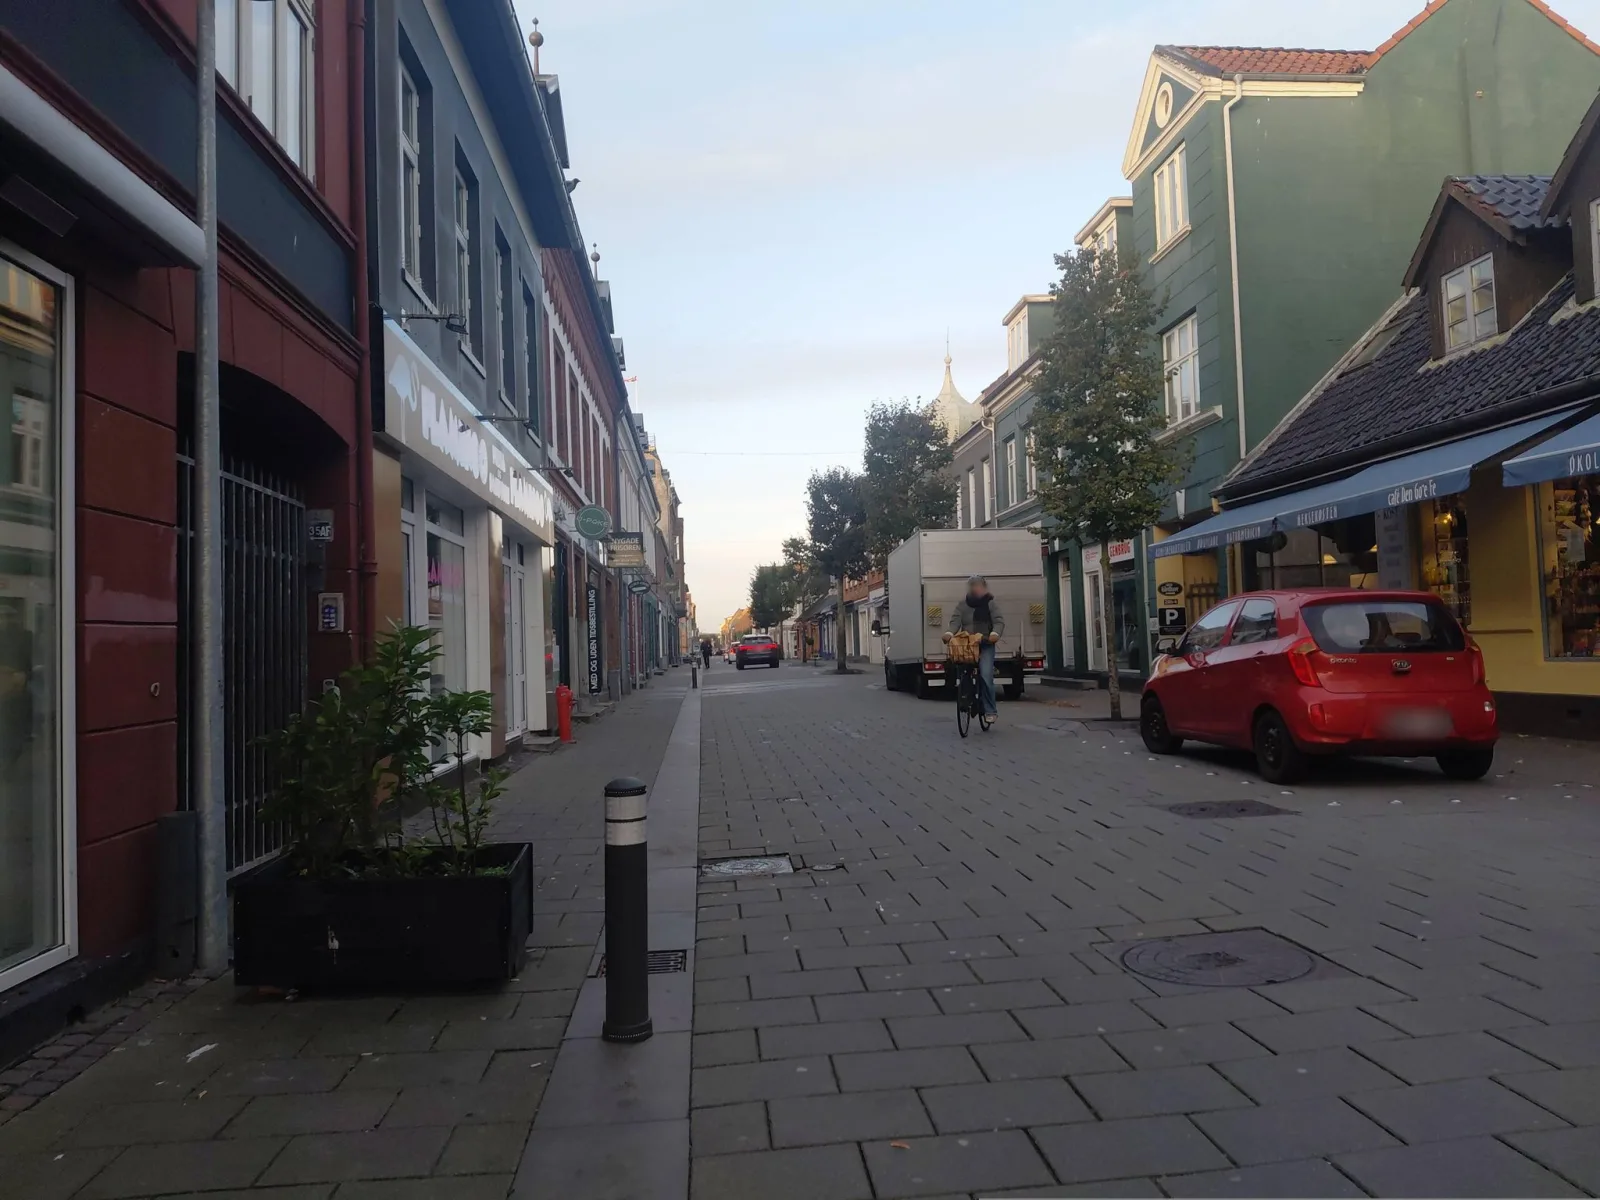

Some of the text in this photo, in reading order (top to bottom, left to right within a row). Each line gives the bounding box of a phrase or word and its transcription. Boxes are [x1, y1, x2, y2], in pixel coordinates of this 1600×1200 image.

[1569, 452, 1600, 475] ØKOL
[1401, 487, 1413, 503] Den
[1165, 608, 1179, 625] P
[588, 589, 598, 690] MED OG UDEN TIDSBESTILLING
